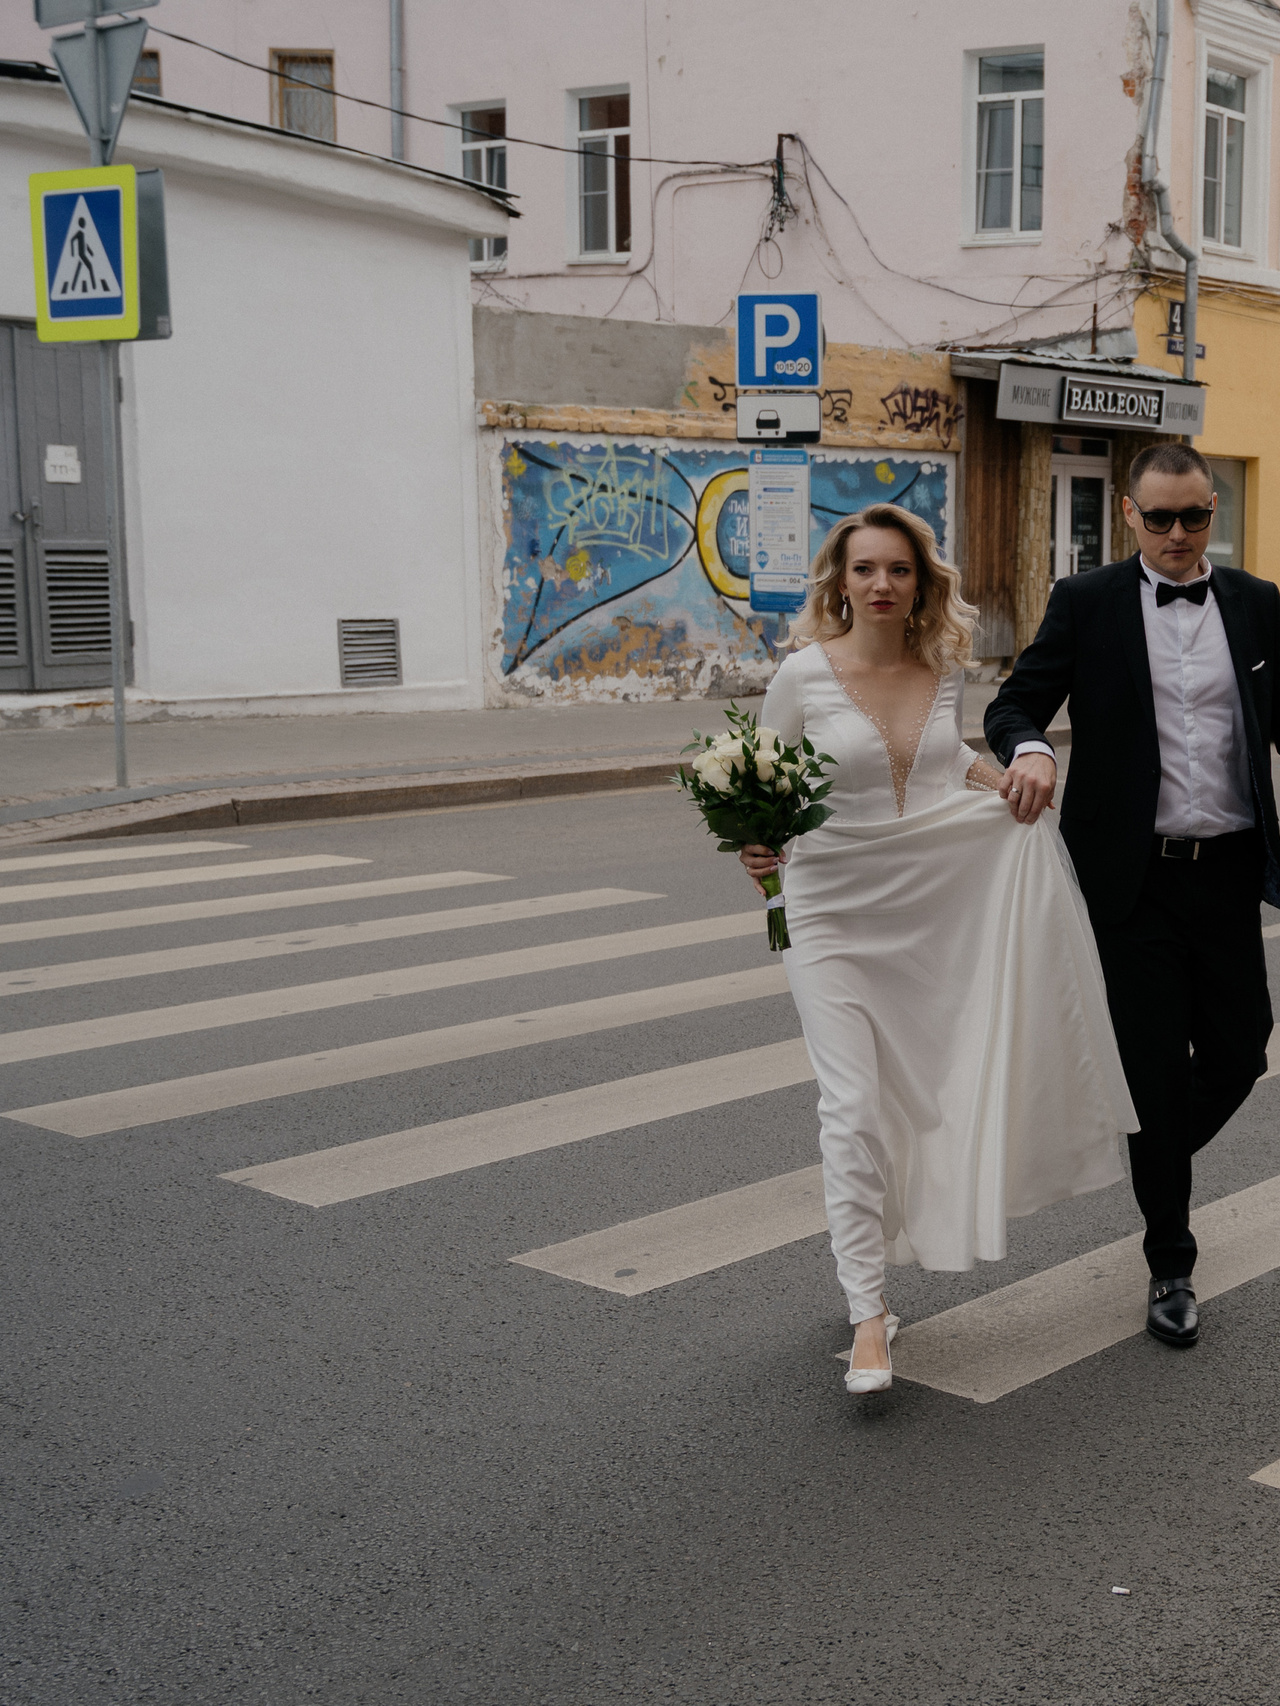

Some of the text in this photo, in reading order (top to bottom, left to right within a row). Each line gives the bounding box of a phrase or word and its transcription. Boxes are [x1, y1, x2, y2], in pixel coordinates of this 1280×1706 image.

[1172, 304, 1181, 333] 4
[754, 303, 801, 377] P
[776, 362, 811, 372] 10 15 20
[1011, 385, 1052, 407] МУЖСКИЕ
[1069, 387, 1160, 418] BARLEONE
[1166, 401, 1199, 422] КОСТЮМЫ
[780, 554, 802, 562] Пн-Пт
